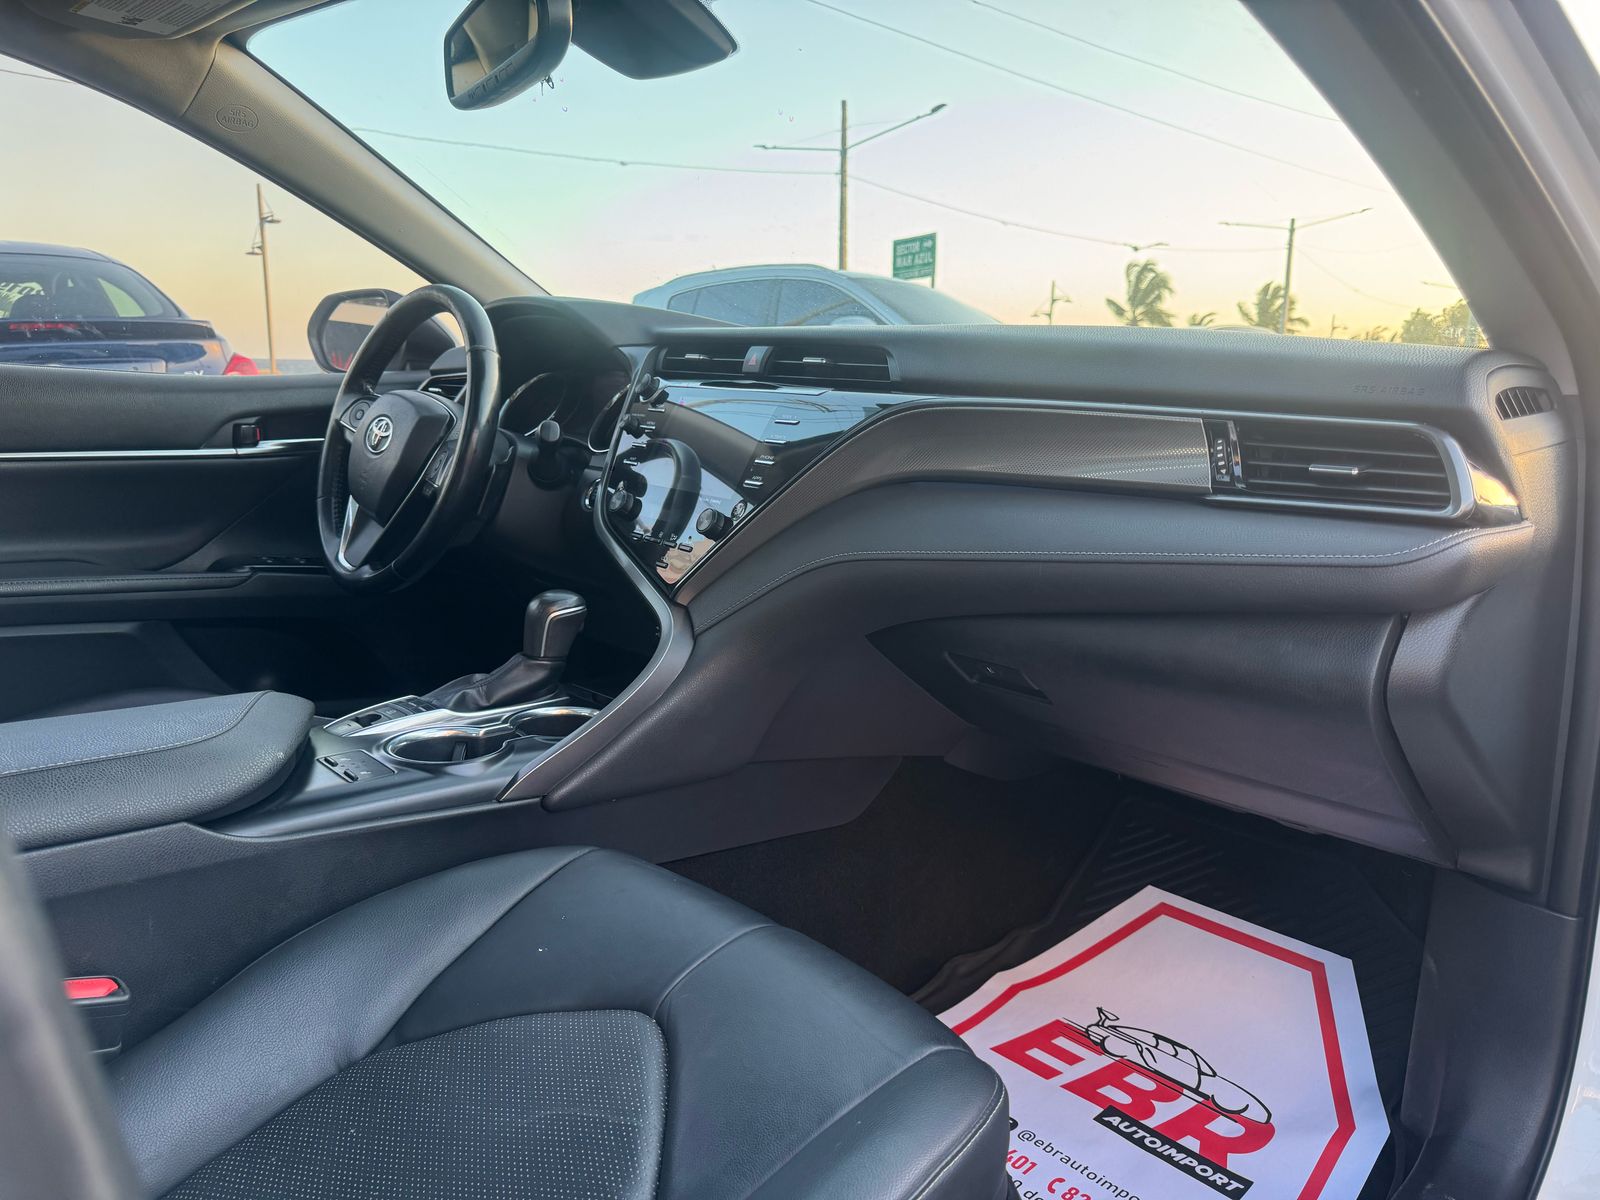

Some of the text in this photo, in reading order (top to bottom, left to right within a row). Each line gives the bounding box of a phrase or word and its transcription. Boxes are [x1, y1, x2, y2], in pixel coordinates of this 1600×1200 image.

[221, 116, 254, 128] AIRBAG
[230, 109, 247, 118] SRS
[990, 1019, 1276, 1169] EBR
[1102, 1115, 1245, 1192] AUTOIMPORT
